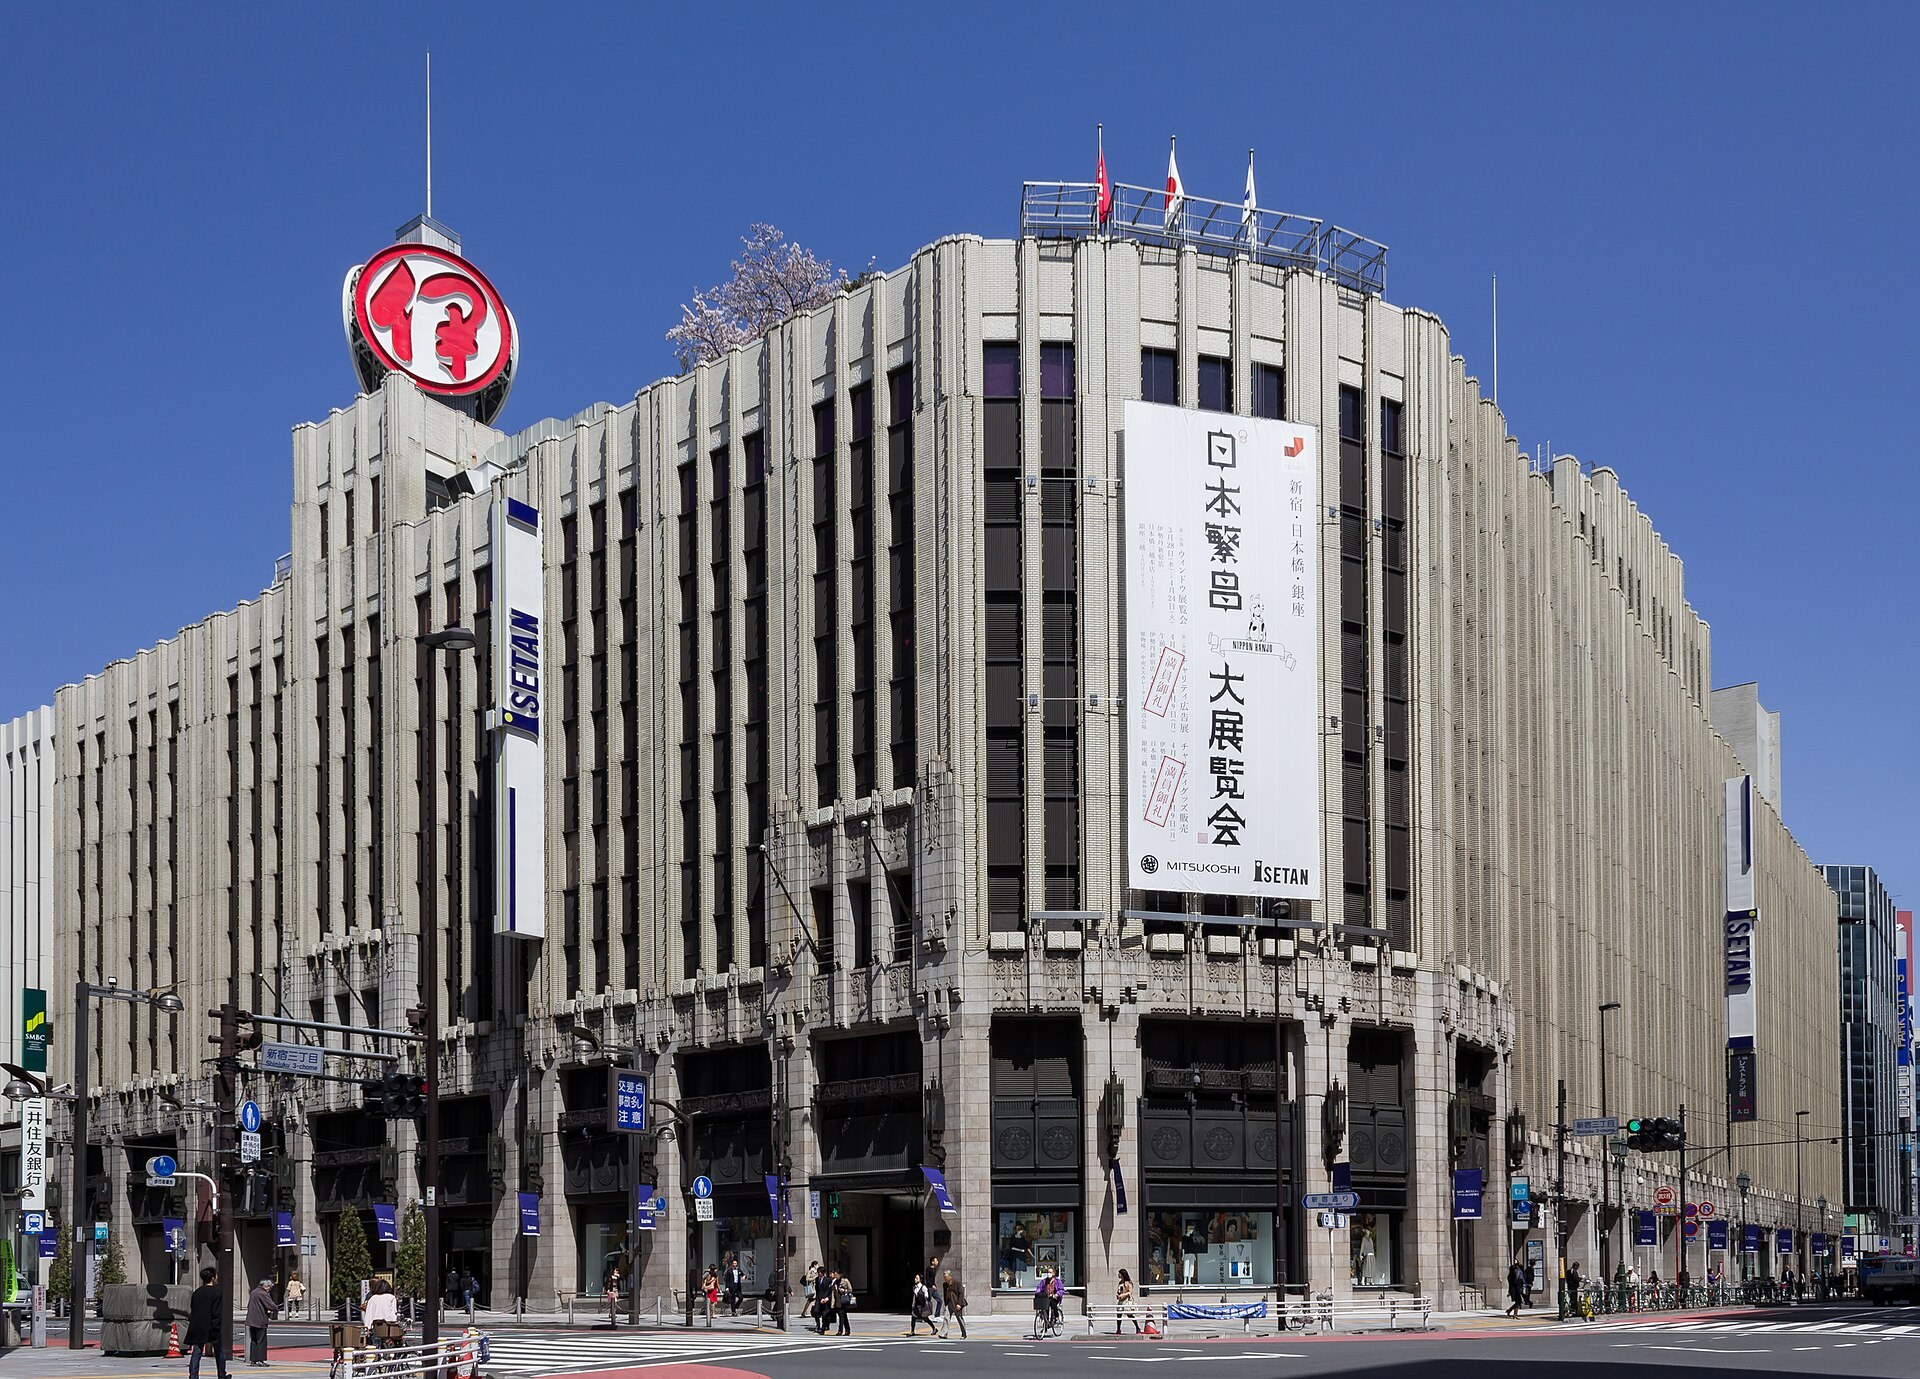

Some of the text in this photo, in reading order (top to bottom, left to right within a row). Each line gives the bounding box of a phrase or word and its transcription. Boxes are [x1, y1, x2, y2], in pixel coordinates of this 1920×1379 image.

[1289, 479, 1305, 618] 新宿・日本橋・銀座
[1204, 426, 1246, 848] 日本繁昌 大展覧会
[1232, 640, 1253, 651] NIPPON
[502, 606, 540, 739] ISETAN
[1166, 861, 1240, 875] MITSUKOSHI
[1253, 860, 1309, 885] ISETAN
[1727, 908, 1757, 986] ISETAN
[25, 1033, 46, 1041] SMBC
[266, 1048, 318, 1064] 新宿三丁目
[292, 1062, 318, 1071] 3-chome
[618, 1080, 644, 1094] 交差点
[618, 1110, 642, 1124] 注意
[1576, 1119, 1615, 1129] 新宿三丁目
